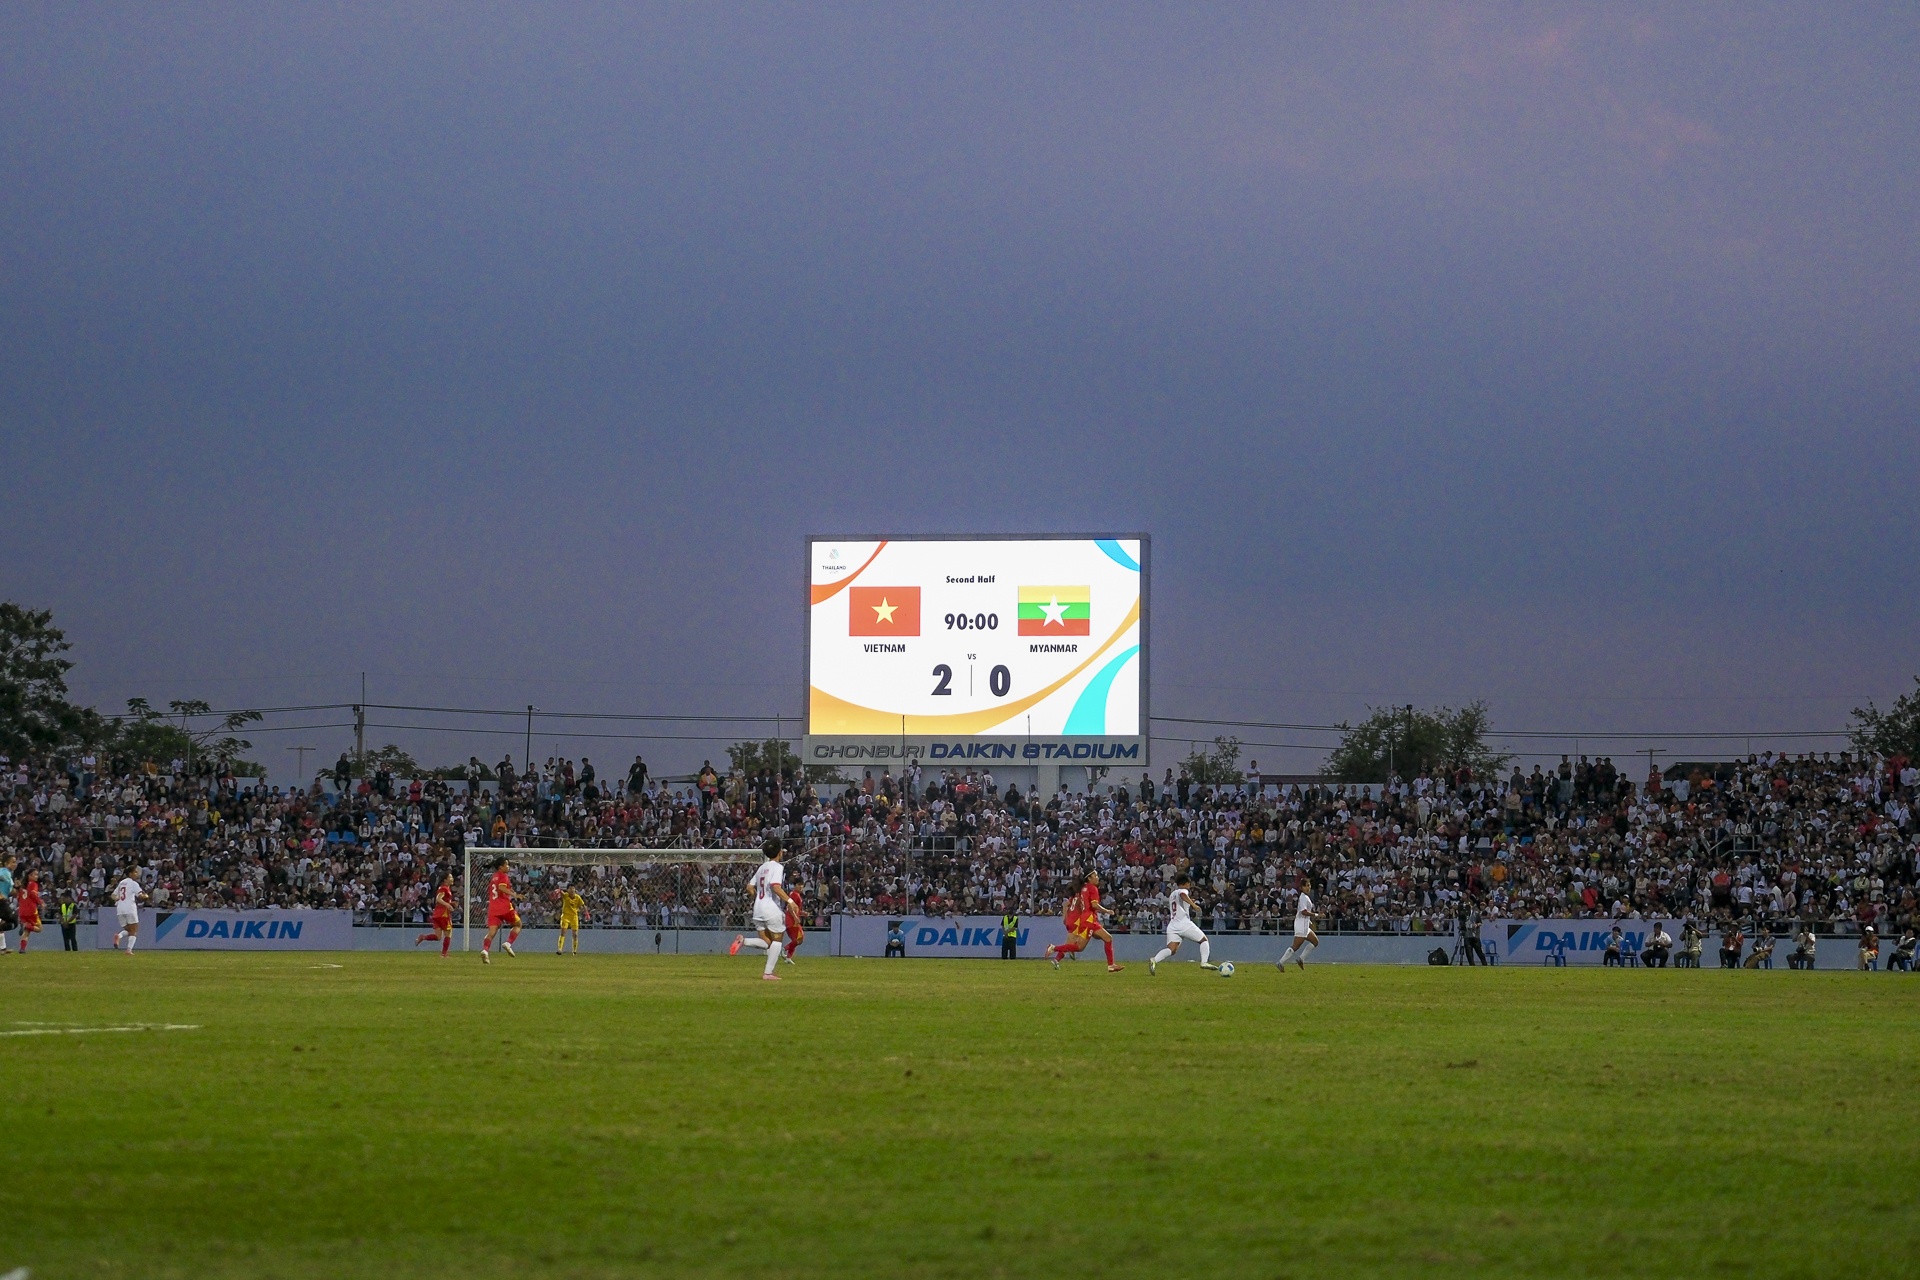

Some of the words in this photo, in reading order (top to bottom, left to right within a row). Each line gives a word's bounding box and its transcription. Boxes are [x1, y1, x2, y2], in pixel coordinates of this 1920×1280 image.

[946, 575, 974, 584] Second
[977, 574, 996, 584] Half
[944, 613, 998, 630] 90:00
[864, 644, 906, 653] VIETNAM
[1029, 644, 1078, 653] MYANMAR
[931, 664, 953, 696] 2
[989, 664, 1011, 697] 0
[814, 744, 926, 759] CHONBURI
[930, 743, 1016, 759] DAIKIN
[1022, 743, 1139, 759] STADIUM
[491, 883, 499, 900] 3
[759, 876, 766, 900] 5
[185, 919, 303, 939] DAIKIN
[1535, 931, 1645, 950] DAIKN
